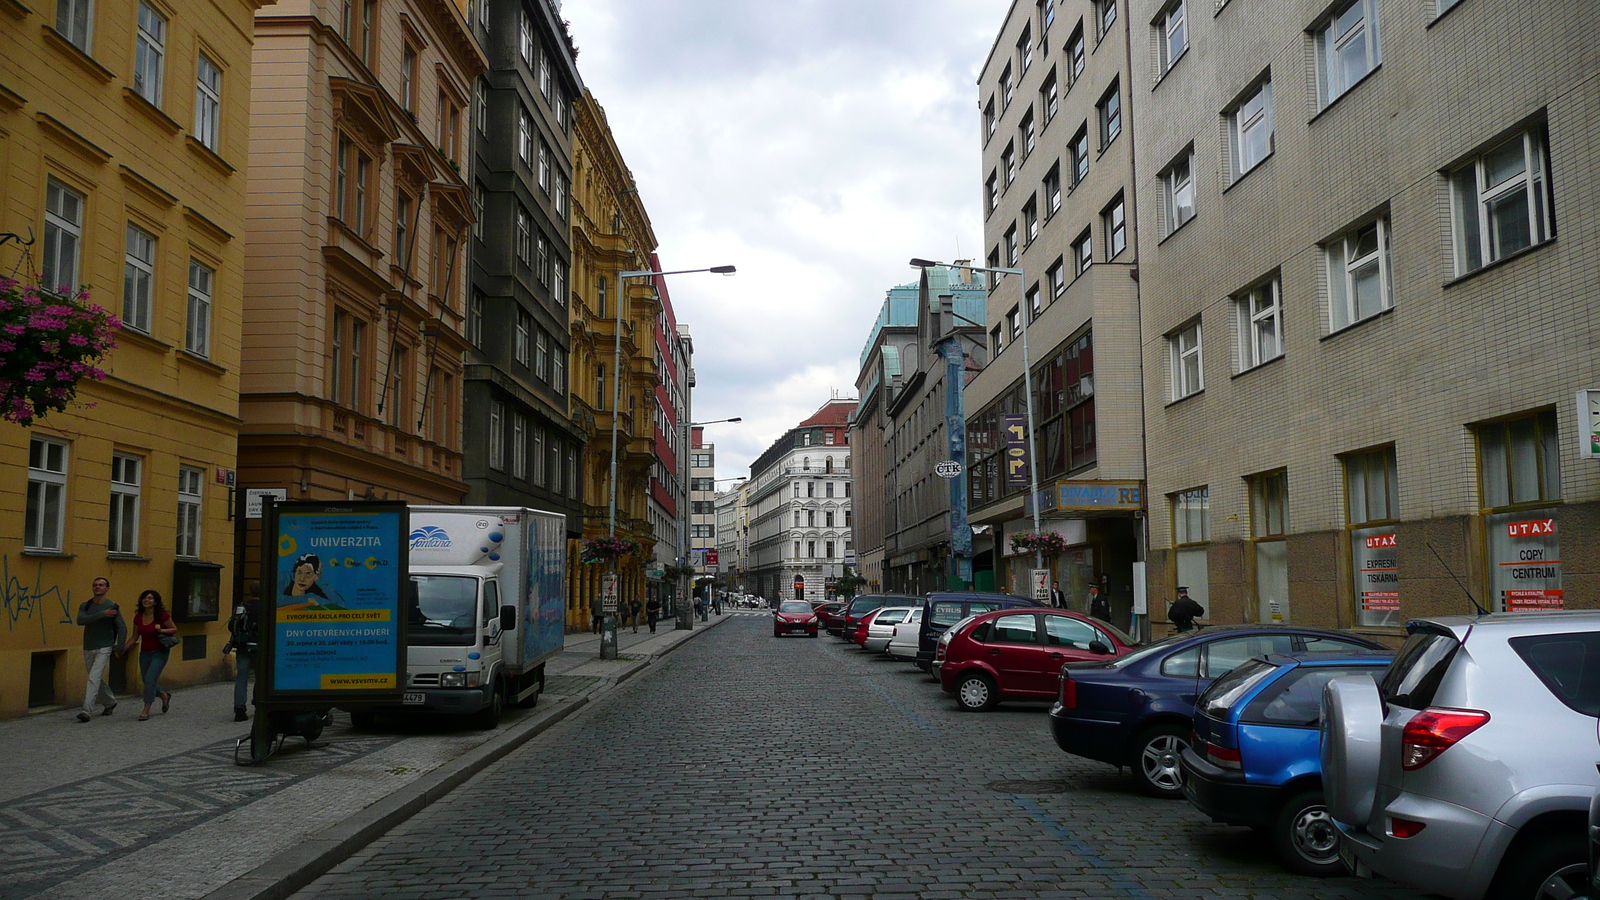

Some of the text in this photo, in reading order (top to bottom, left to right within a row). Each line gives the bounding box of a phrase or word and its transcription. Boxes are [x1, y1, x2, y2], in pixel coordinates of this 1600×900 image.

[937, 463, 960, 473] ČTK
[1061, 487, 1117, 498] DIVADLO
[1509, 519, 1553, 536] UTAX
[310, 537, 382, 548] UNIVERZITA
[410, 537, 452, 551] fontana
[1366, 534, 1396, 547] UTAX
[1520, 549, 1544, 561] COPY
[1367, 572, 1399, 583] TISKÁRNA
[1512, 567, 1556, 579] CENTRUM
[306, 628, 362, 637] OTEVŘENÝCH
[403, 694, 423, 702] 4479
